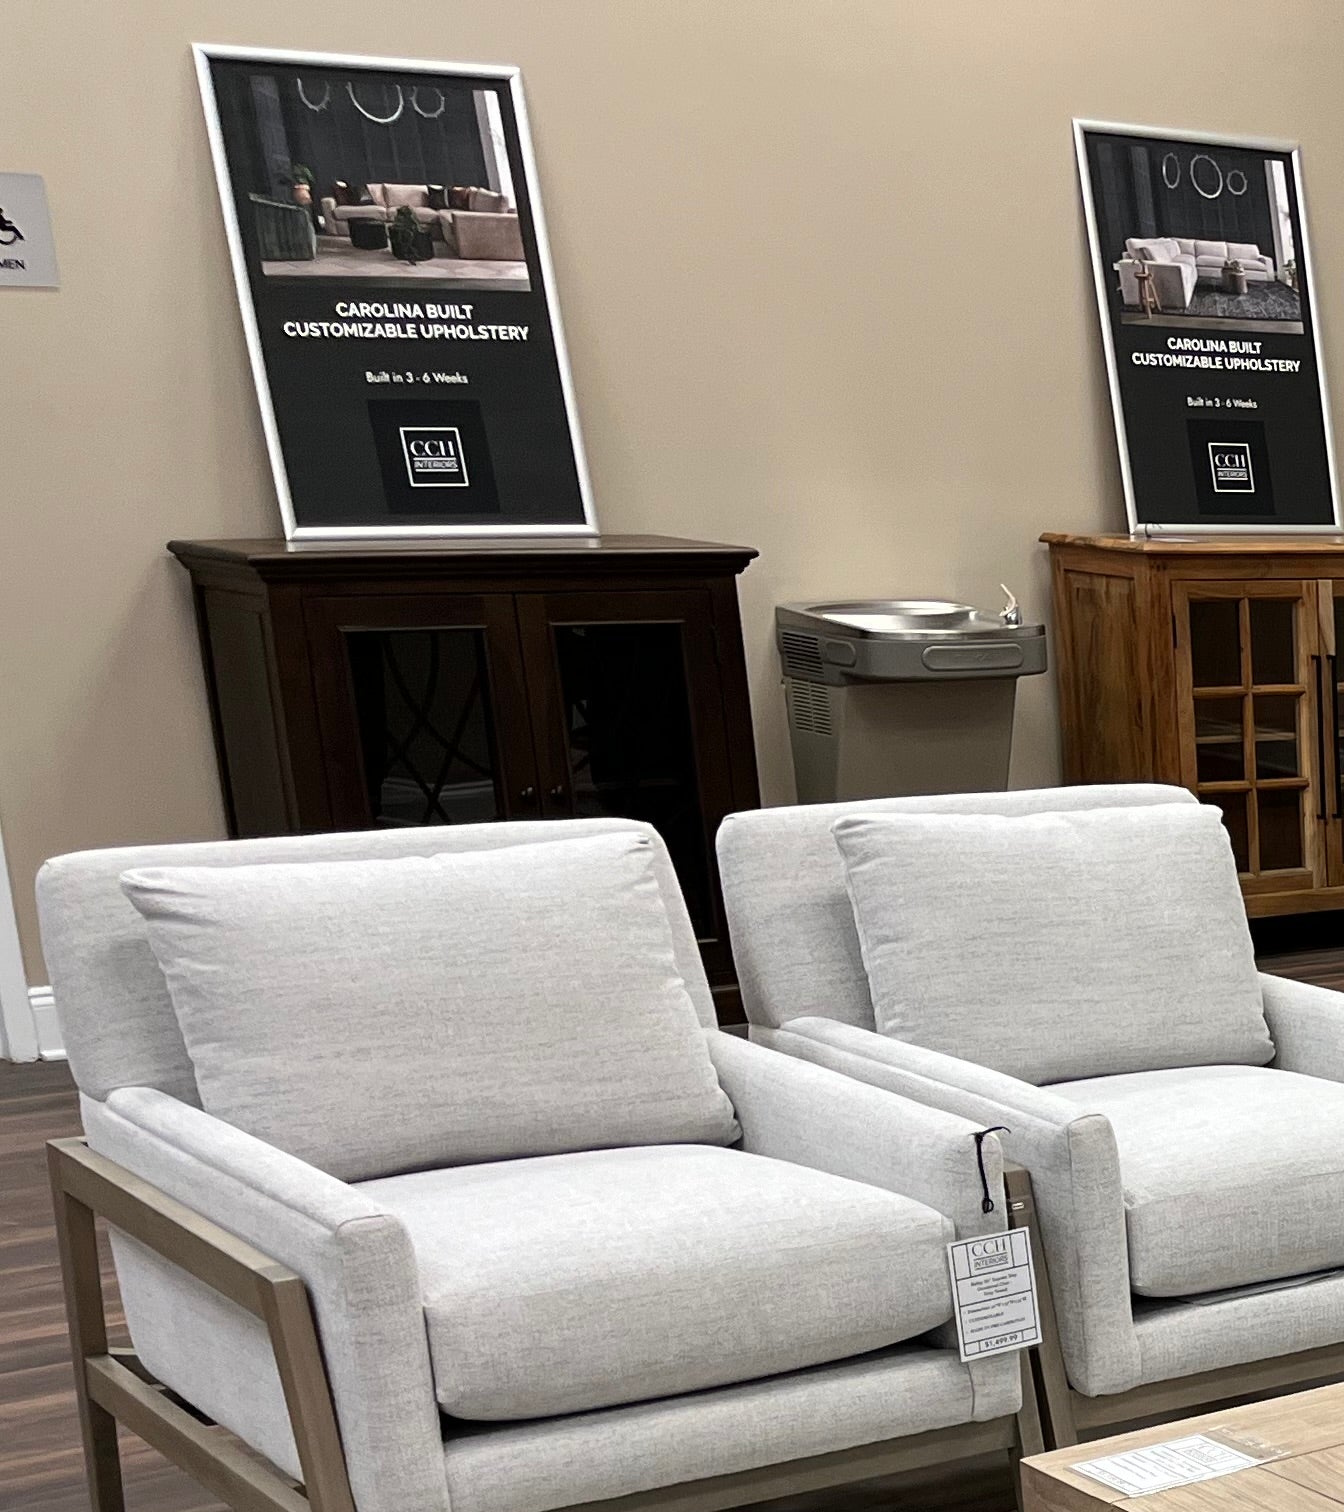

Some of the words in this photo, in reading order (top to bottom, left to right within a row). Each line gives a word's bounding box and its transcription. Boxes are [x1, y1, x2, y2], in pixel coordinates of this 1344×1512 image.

[335, 302, 424, 319] CAROLINA
[425, 304, 474, 319] BUILT
[283, 321, 419, 339] CUSTOMIZABLE
[420, 324, 530, 341] UPHOLSTERY
[1167, 337, 1227, 353] CAROLINA
[1228, 341, 1262, 354] BUILT
[1132, 352, 1224, 370] CUSTOMIZABLE
[1225, 358, 1301, 372] UPHOLSTERY
[365, 371, 390, 383] Built
[392, 371, 404, 383] in
[405, 372, 414, 383] 3
[422, 372, 431, 383] 6
[432, 372, 469, 384] Weeks
[1187, 396, 1204, 407] Built
[1205, 396, 1213, 407] in
[1214, 397, 1220, 408] 3
[1225, 398, 1232, 408] 6
[1232, 398, 1258, 409] Weeks
[410, 440, 455, 456] CCH
[413, 460, 459, 469] INTERIORS
[1214, 453, 1246, 468] CCH
[971, 1238, 1007, 1257] CCH
[974, 1255, 1009, 1269] INTERIORS
